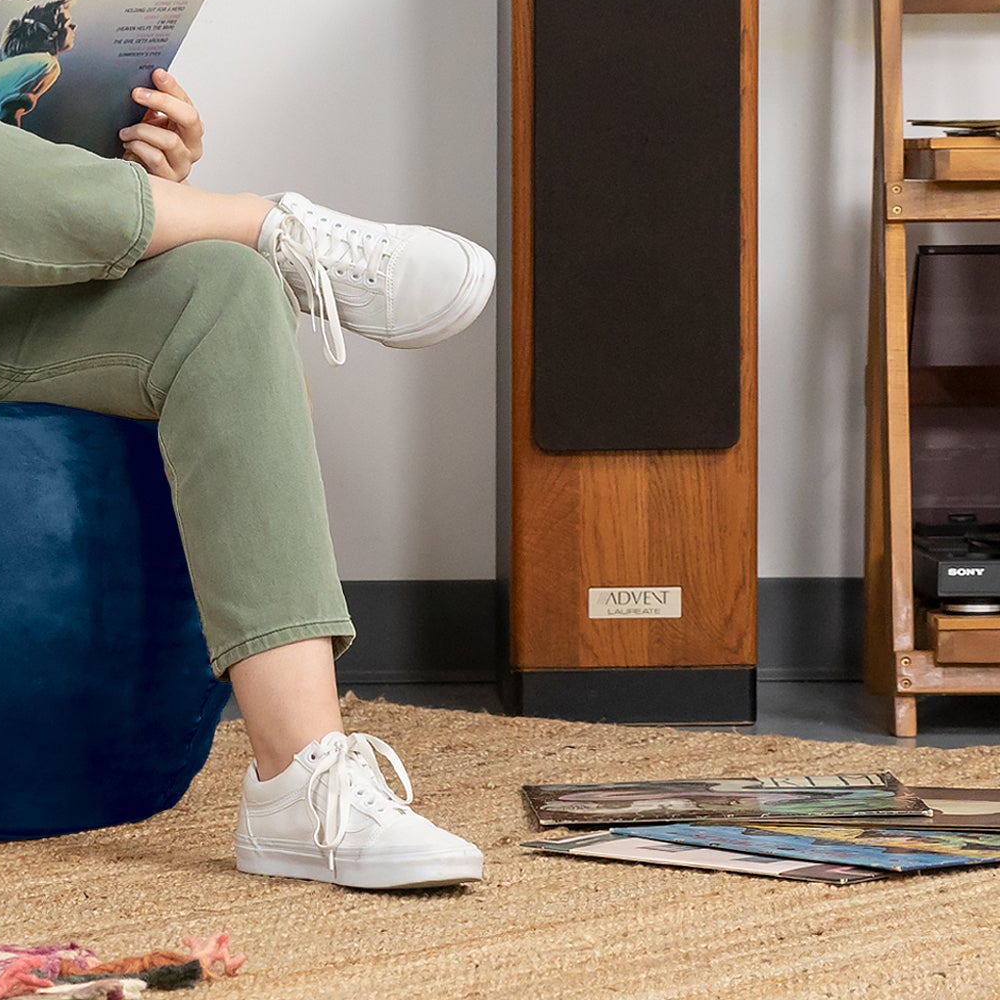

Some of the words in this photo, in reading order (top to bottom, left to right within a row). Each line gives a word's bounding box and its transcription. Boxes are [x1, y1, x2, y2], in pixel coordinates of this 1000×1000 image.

[947, 567, 985, 576] SONY
[604, 590, 669, 606] ADVENT
[607, 607, 661, 616] LAUREATE
